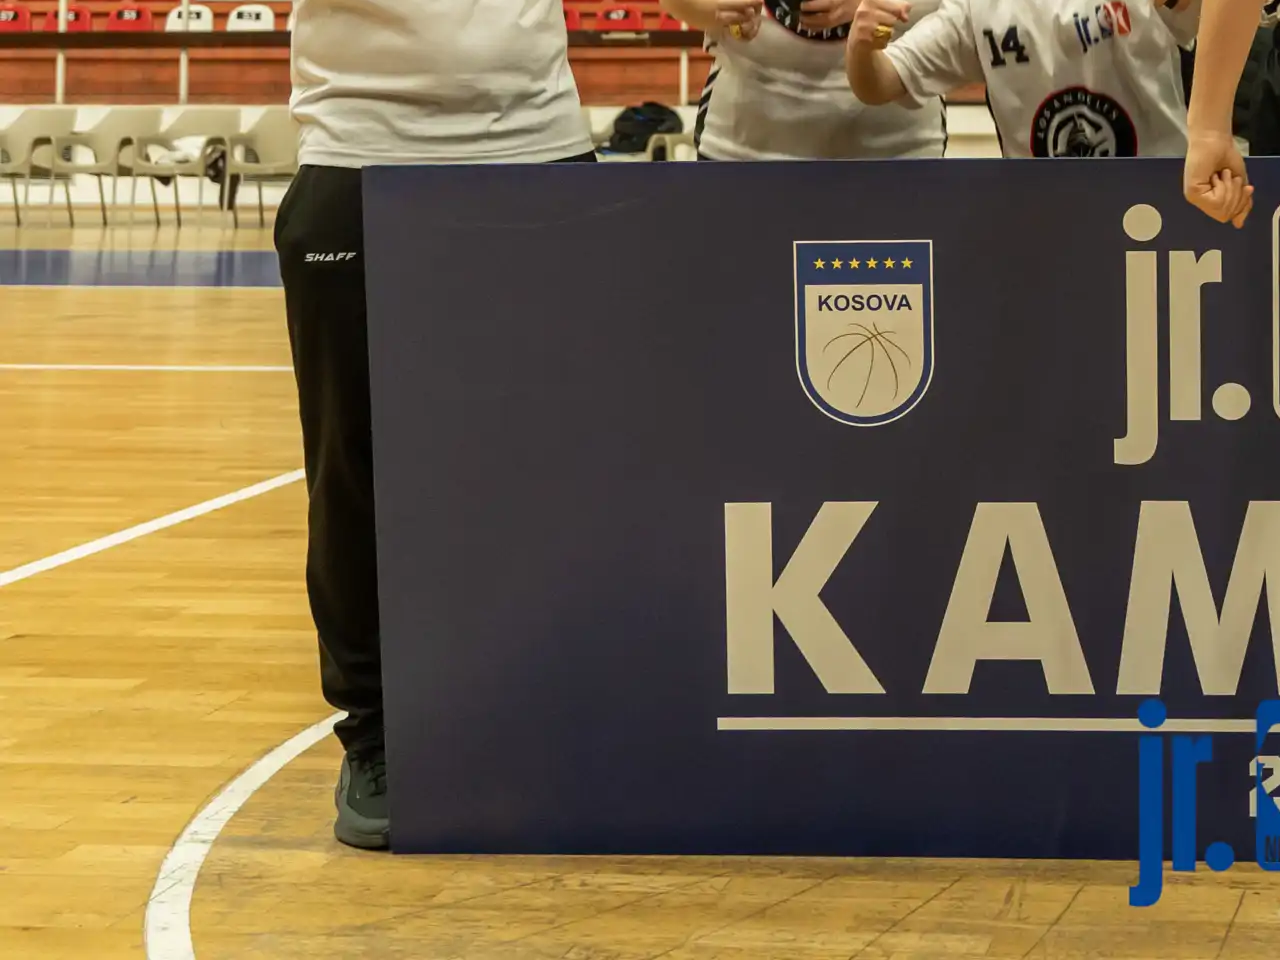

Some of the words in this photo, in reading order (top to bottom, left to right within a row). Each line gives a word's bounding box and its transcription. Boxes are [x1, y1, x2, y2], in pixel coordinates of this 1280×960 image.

[983, 25, 1030, 67] 14
[304, 251, 357, 262] SHAFF
[817, 294, 913, 312] KOSOVA
[1113, 203, 1252, 466] jr.
